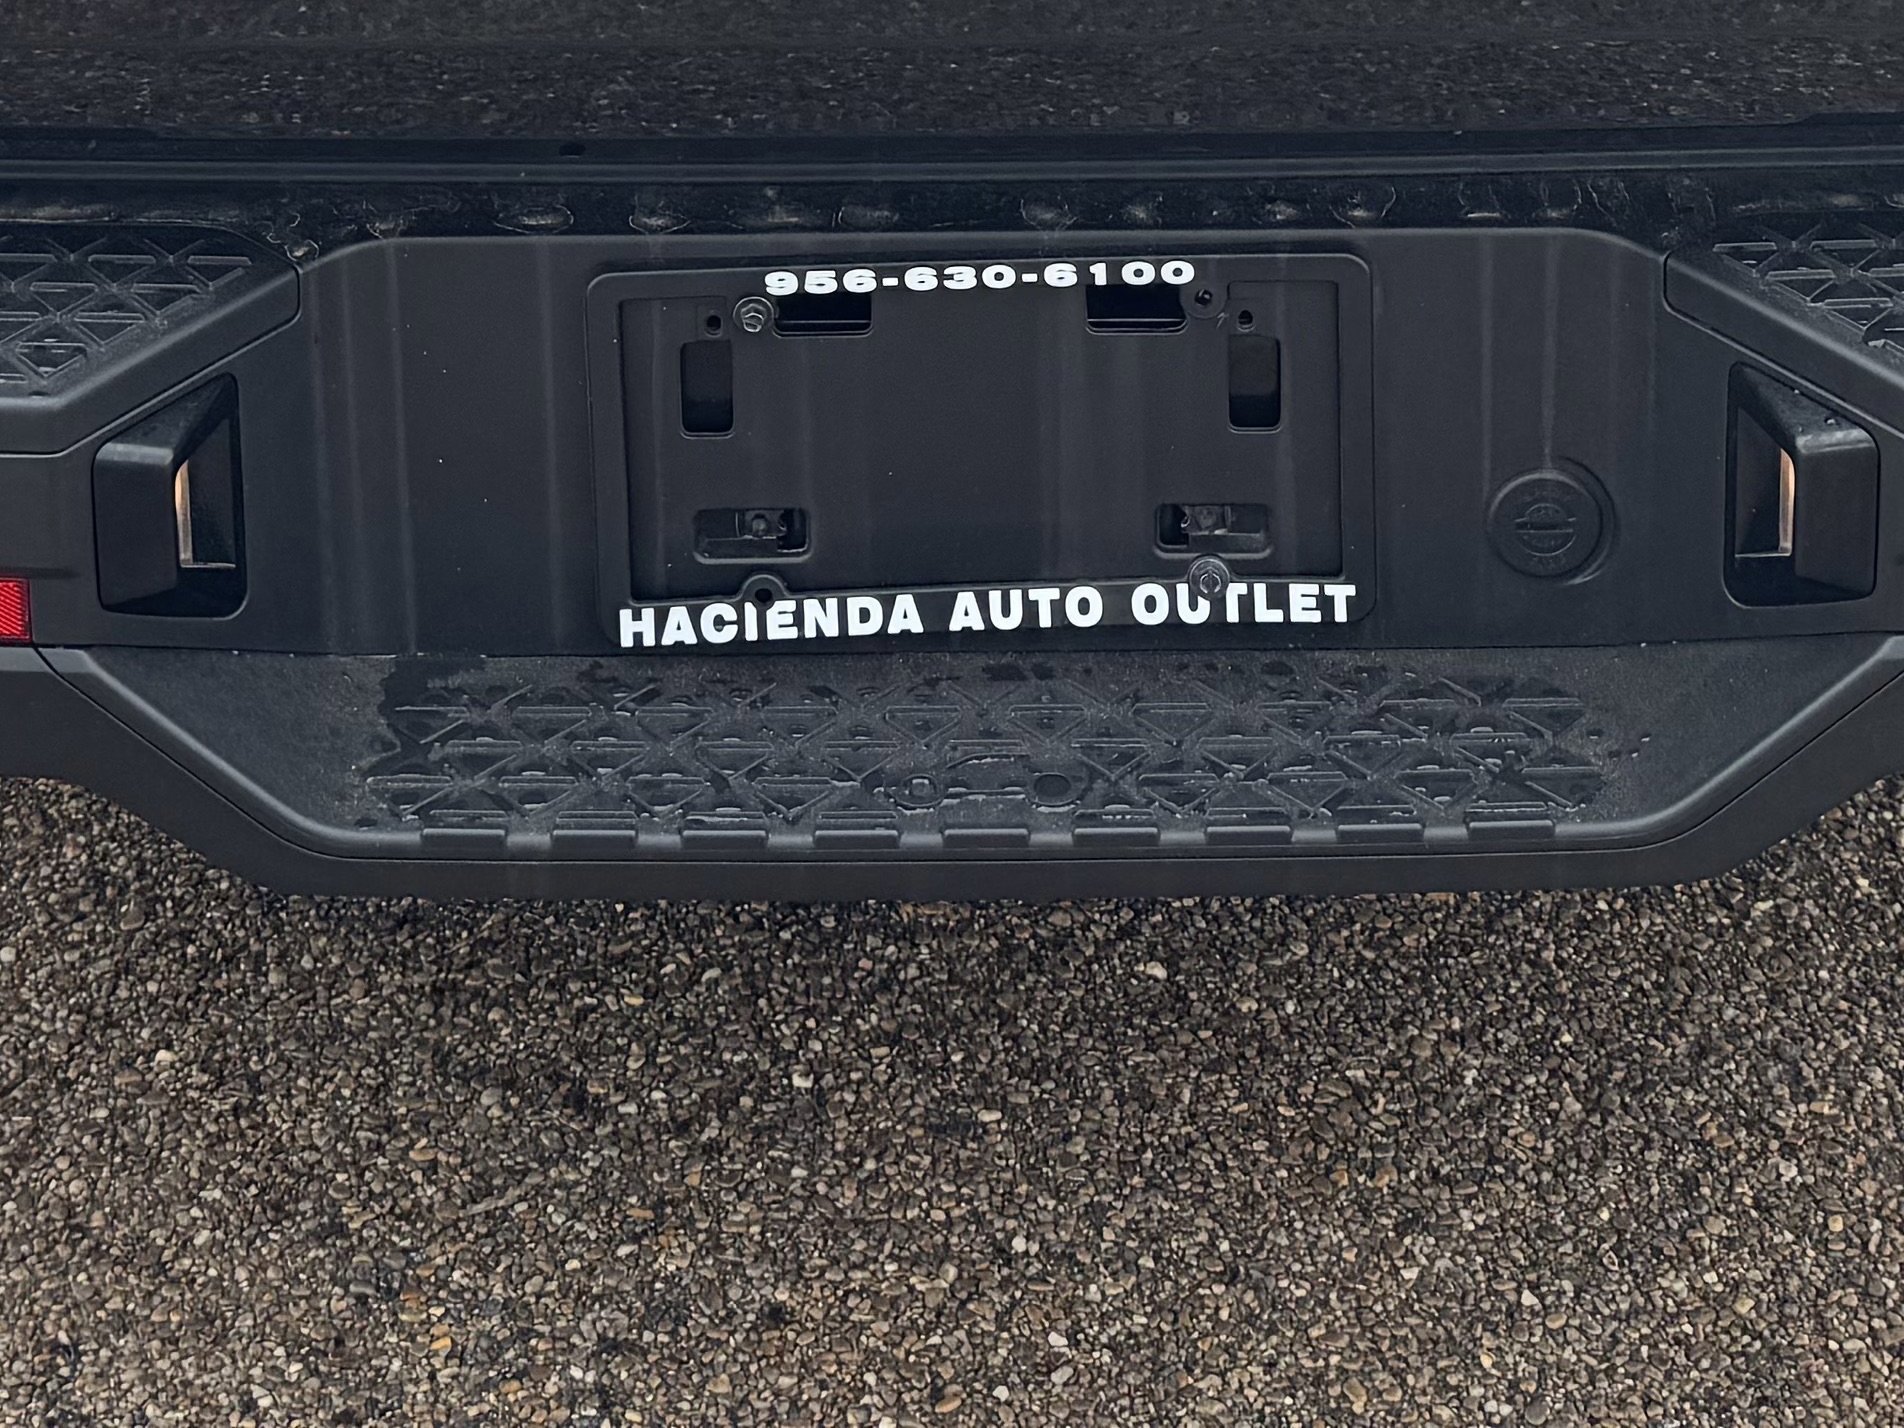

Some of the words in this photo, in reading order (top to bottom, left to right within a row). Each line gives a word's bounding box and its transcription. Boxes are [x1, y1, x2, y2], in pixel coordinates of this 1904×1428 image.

[763, 259, 1197, 297] 956-630-6100
[618, 592, 925, 649] HACIENDA
[947, 585, 1101, 632] AUTO
[1130, 581, 1357, 626] OUTLET
